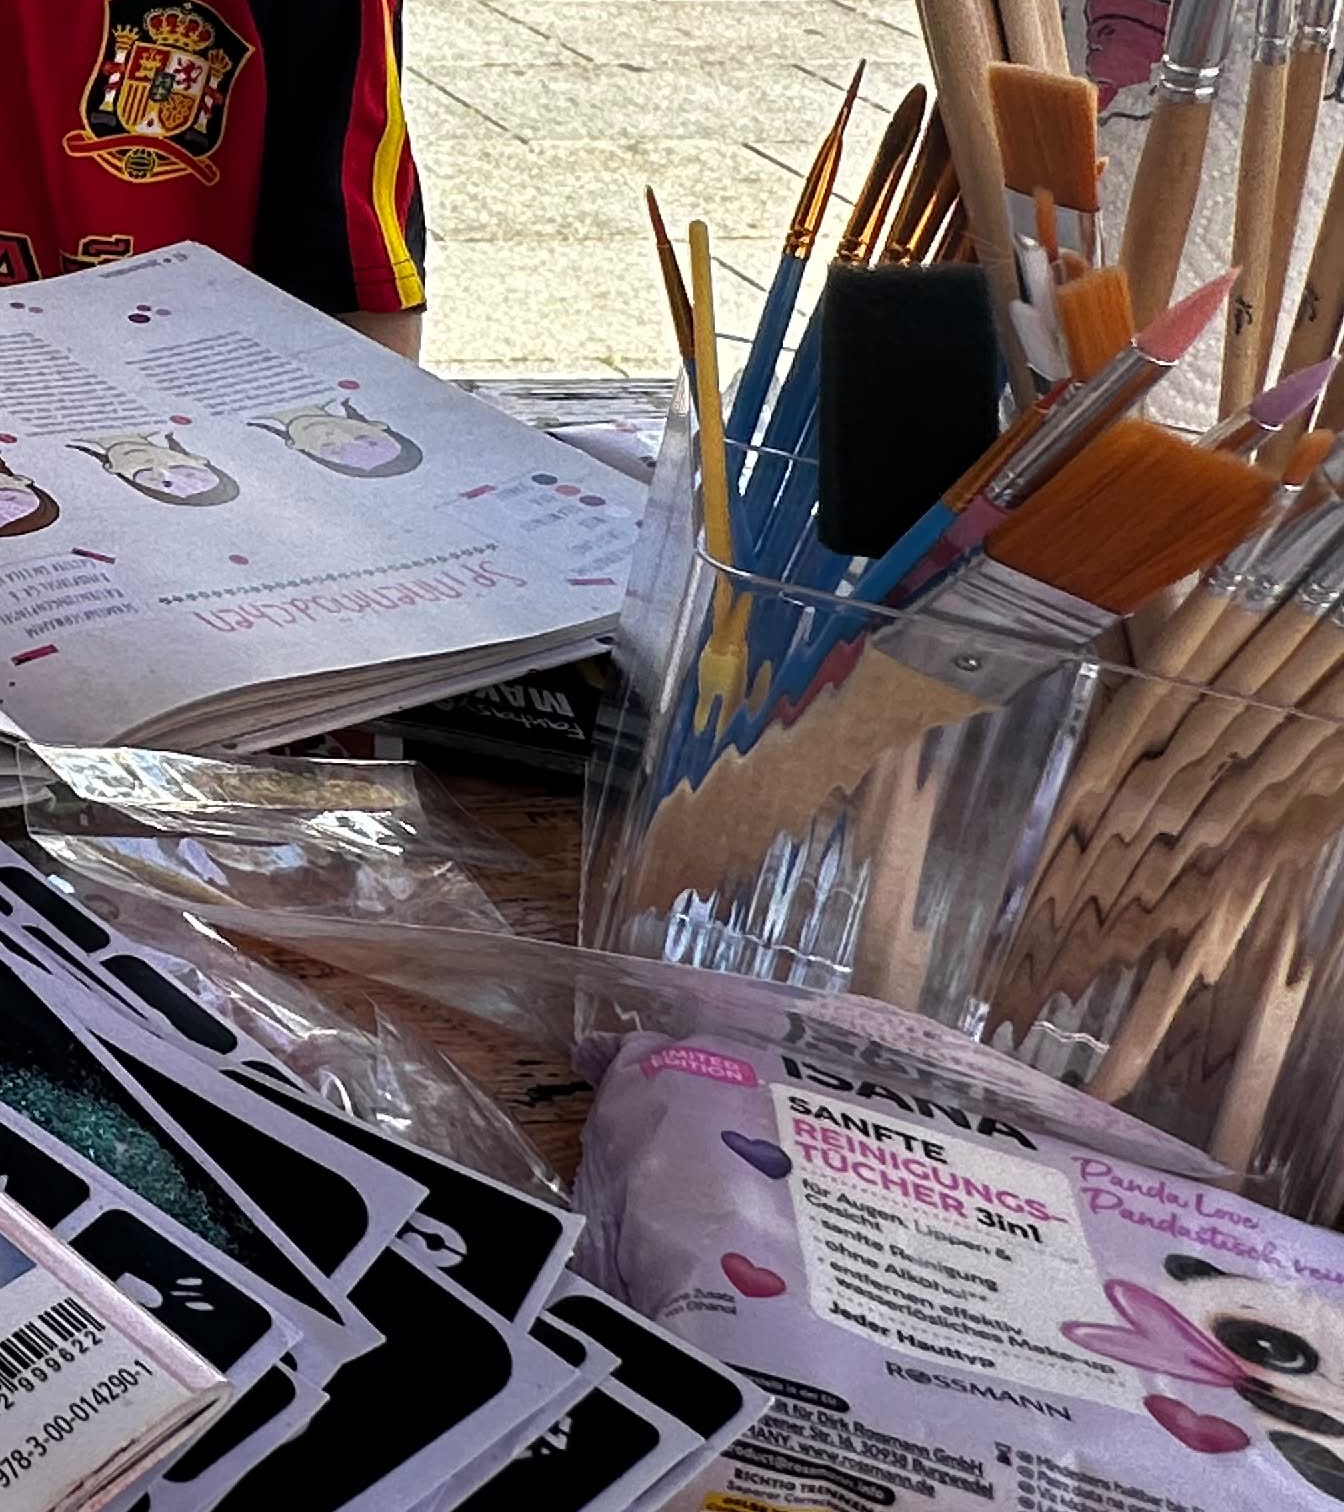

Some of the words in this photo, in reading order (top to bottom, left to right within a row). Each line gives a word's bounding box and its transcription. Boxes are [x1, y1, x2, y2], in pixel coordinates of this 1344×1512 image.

[787, 1095, 949, 1165] SANFTE
[975, 1206, 1044, 1244] 3in1
[885, 1360, 1073, 1423] ROSSMANN
